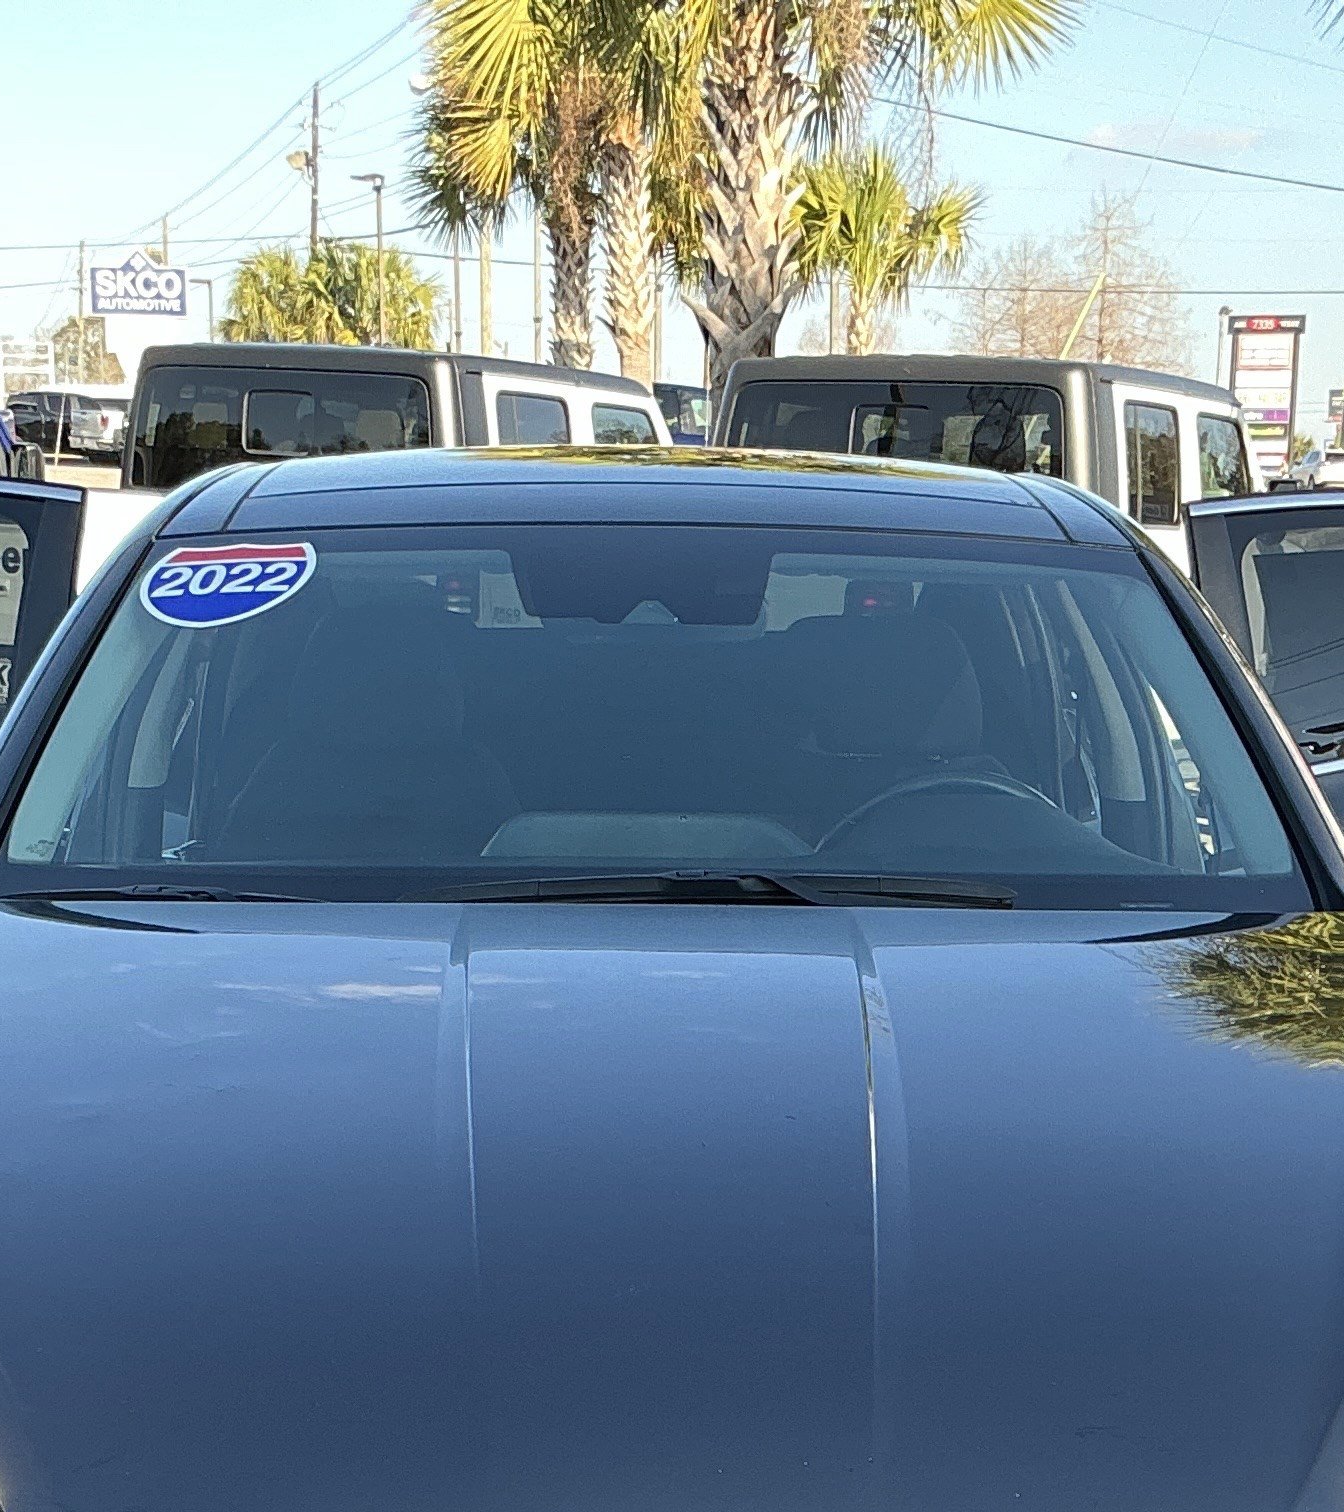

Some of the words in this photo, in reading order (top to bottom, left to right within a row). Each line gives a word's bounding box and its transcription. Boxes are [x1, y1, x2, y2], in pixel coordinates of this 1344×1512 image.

[95, 269, 182, 299] SKCO
[97, 298, 182, 312] AUTOMOTIVE
[150, 562, 298, 598] 2022
